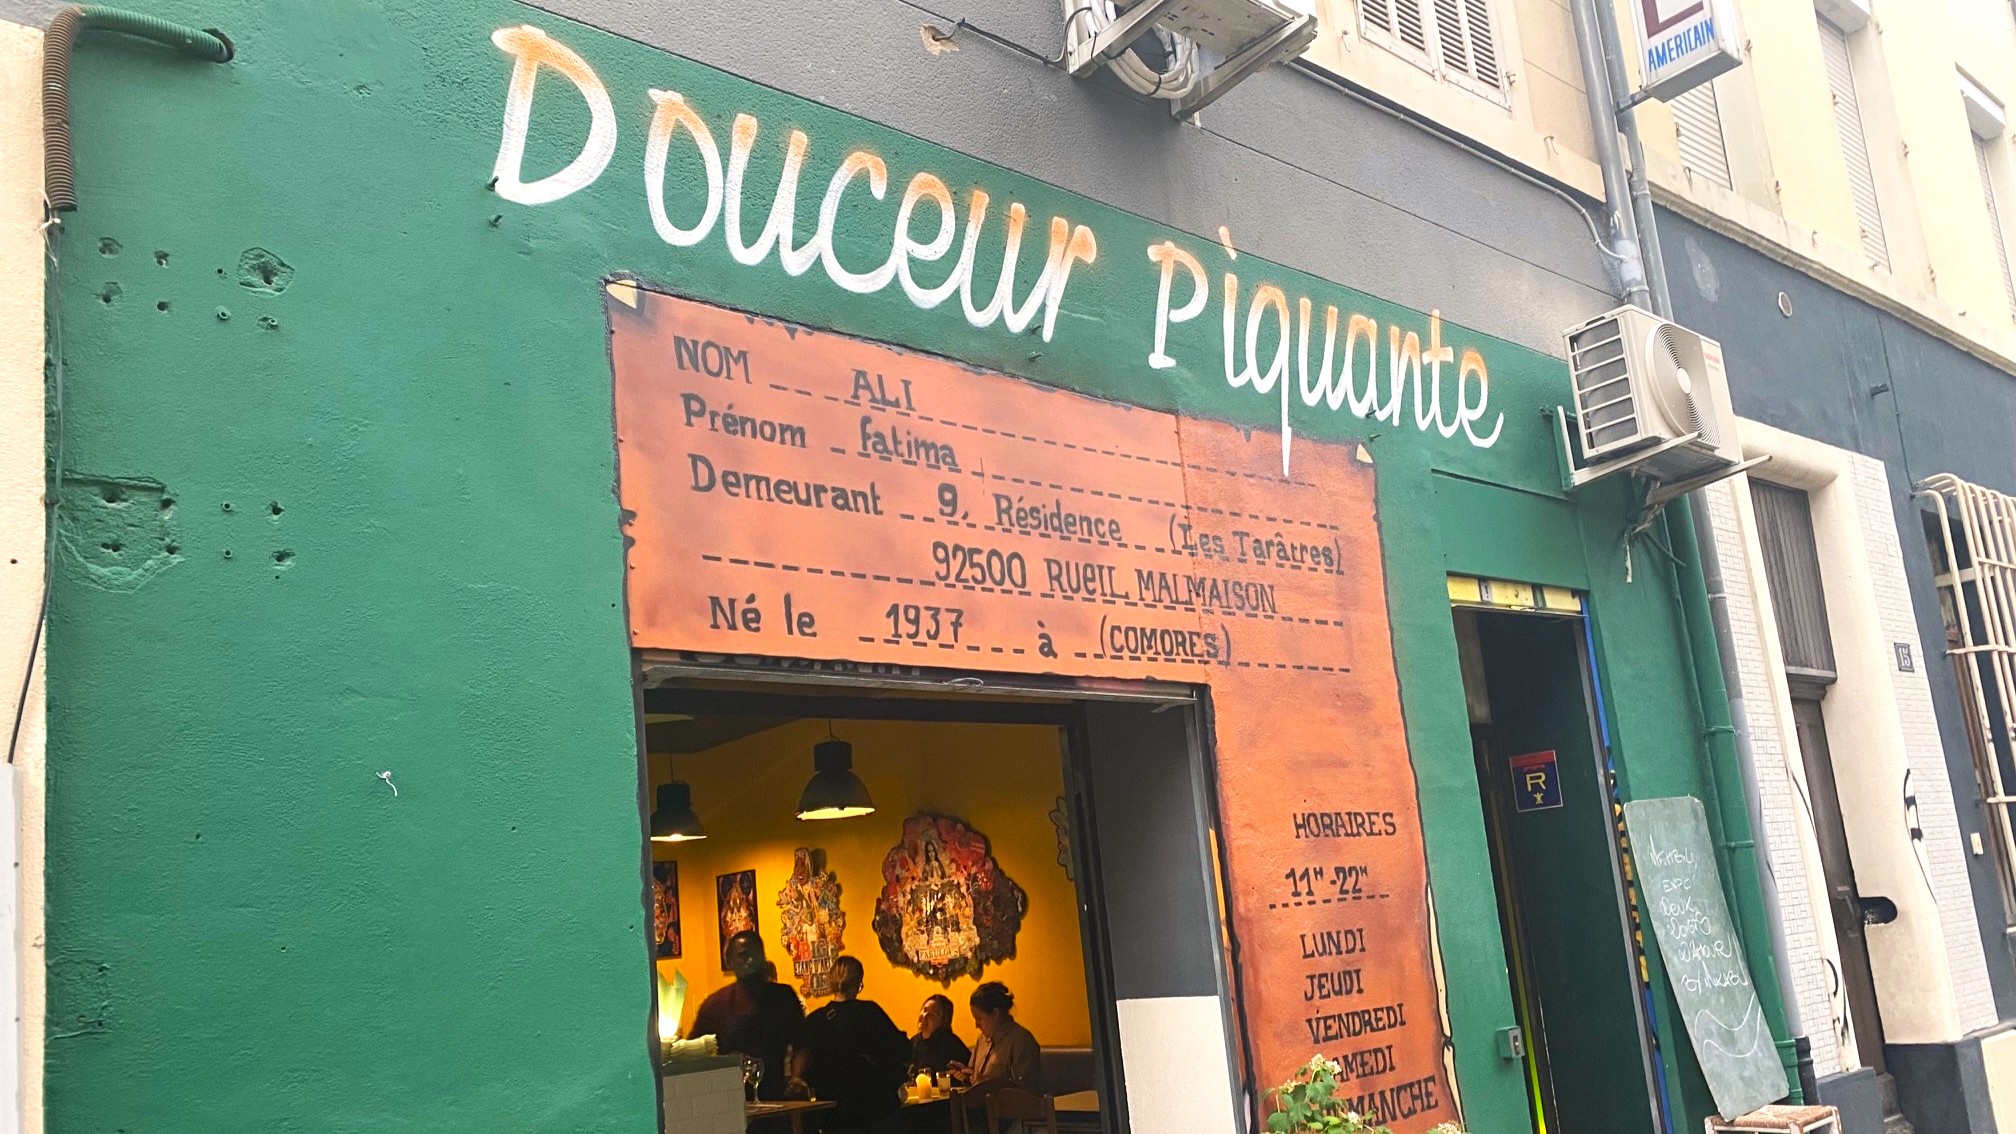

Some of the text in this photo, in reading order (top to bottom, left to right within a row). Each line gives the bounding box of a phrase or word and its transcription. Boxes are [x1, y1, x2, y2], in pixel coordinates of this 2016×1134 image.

[1648, 18, 1716, 72] AMERICAIN
[491, 25, 1504, 476] Douceur Piquante
[673, 336, 916, 411] NOM ALI
[680, 393, 959, 468] Prénom fatima
[688, 454, 884, 515] Demeurant
[937, 483, 970, 521] 9,
[992, 493, 1123, 543] Résidence
[1169, 513, 1226, 555] (Les
[932, 541, 1027, 589] 92500
[1135, 568, 1279, 614] MALMAISON
[709, 592, 1231, 666] Né le 1937 à (COMORES)
[1898, 647, 1911, 668] 15
[1525, 772, 1547, 792] R
[1292, 811, 1397, 839] HORAIRES
[1300, 928, 1366, 959] LUNDI
[1304, 969, 1364, 1001] JEUDI
[1305, 1003, 1406, 1044] VENDREDI
[1330, 1044, 1396, 1083] AMEDI
[1324, 1075, 1439, 1126] MANCHE
